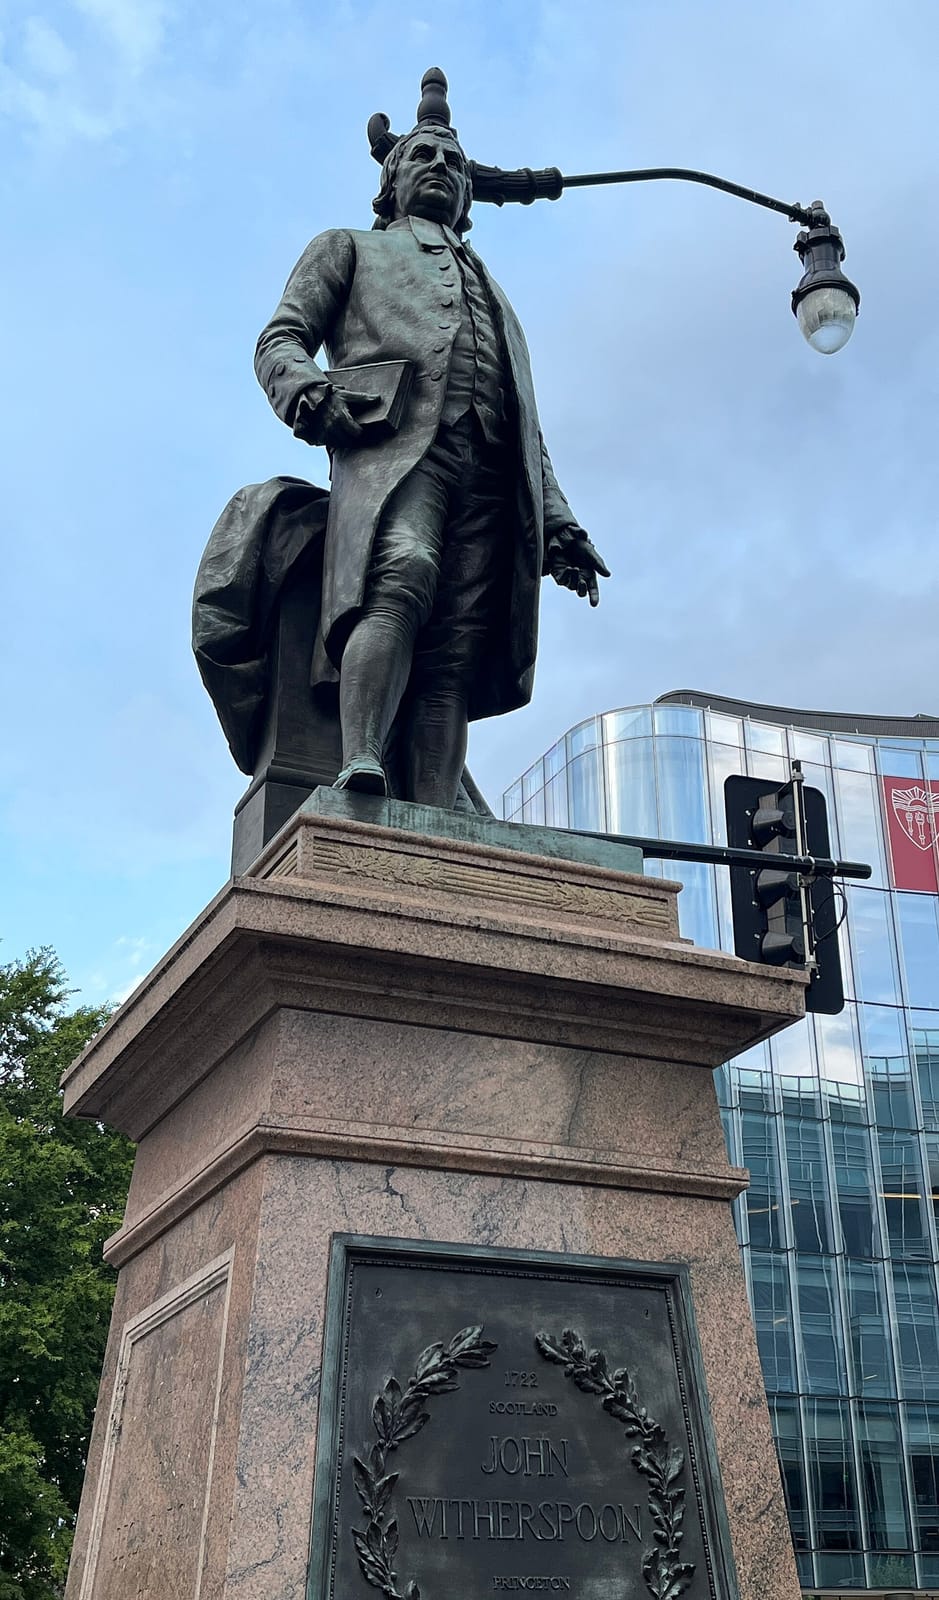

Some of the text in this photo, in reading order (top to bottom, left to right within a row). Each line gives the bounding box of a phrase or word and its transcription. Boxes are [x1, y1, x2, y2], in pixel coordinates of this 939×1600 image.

[504, 1371, 538, 1388] 1722
[489, 1401, 558, 1416] SCOTLAND
[481, 1436, 569, 1477] JOHN
[407, 1498, 643, 1543] WITHERSPOON
[492, 1576, 570, 1590] PRINCETON
